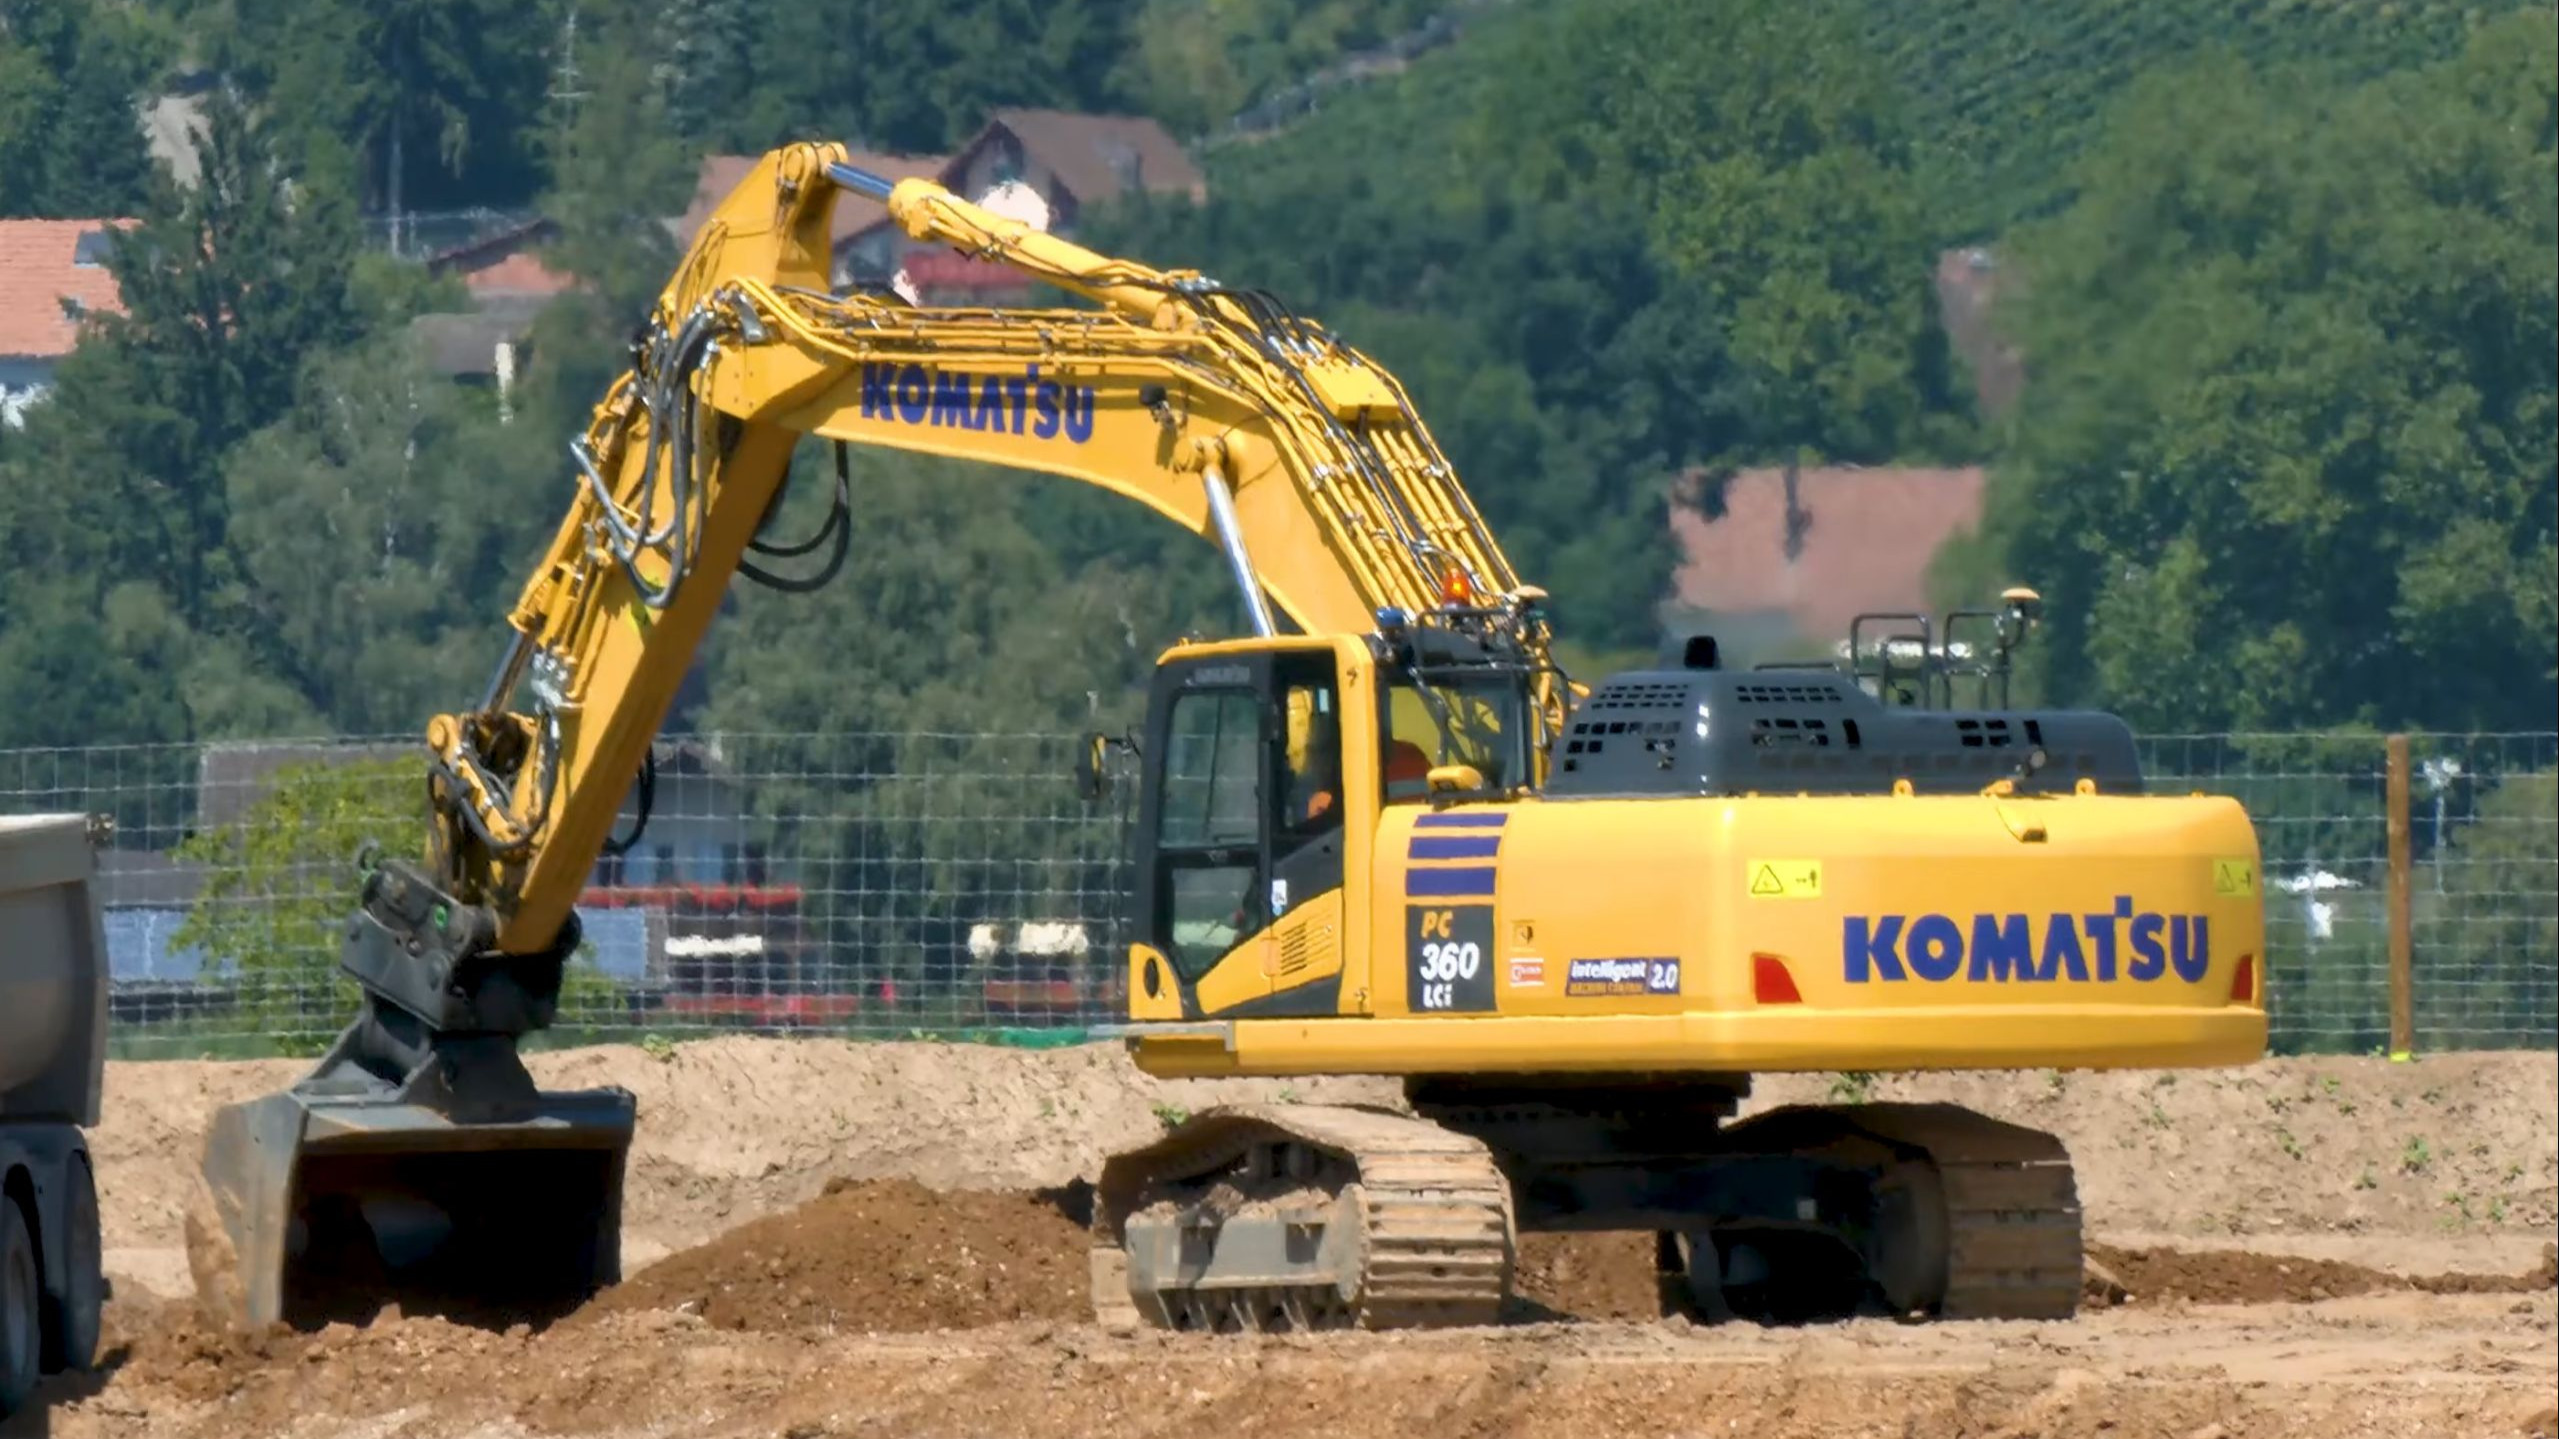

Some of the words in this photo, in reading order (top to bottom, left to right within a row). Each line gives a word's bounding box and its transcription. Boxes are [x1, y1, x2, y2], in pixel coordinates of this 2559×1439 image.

[861, 362, 1094, 444] KOMATSU
[1421, 910, 1453, 938] PC
[1843, 896, 2209, 982] KOMATSU
[1419, 941, 1480, 981] 360
[1650, 963, 1678, 989] 2.0
[1422, 983, 1452, 1008] LCi
